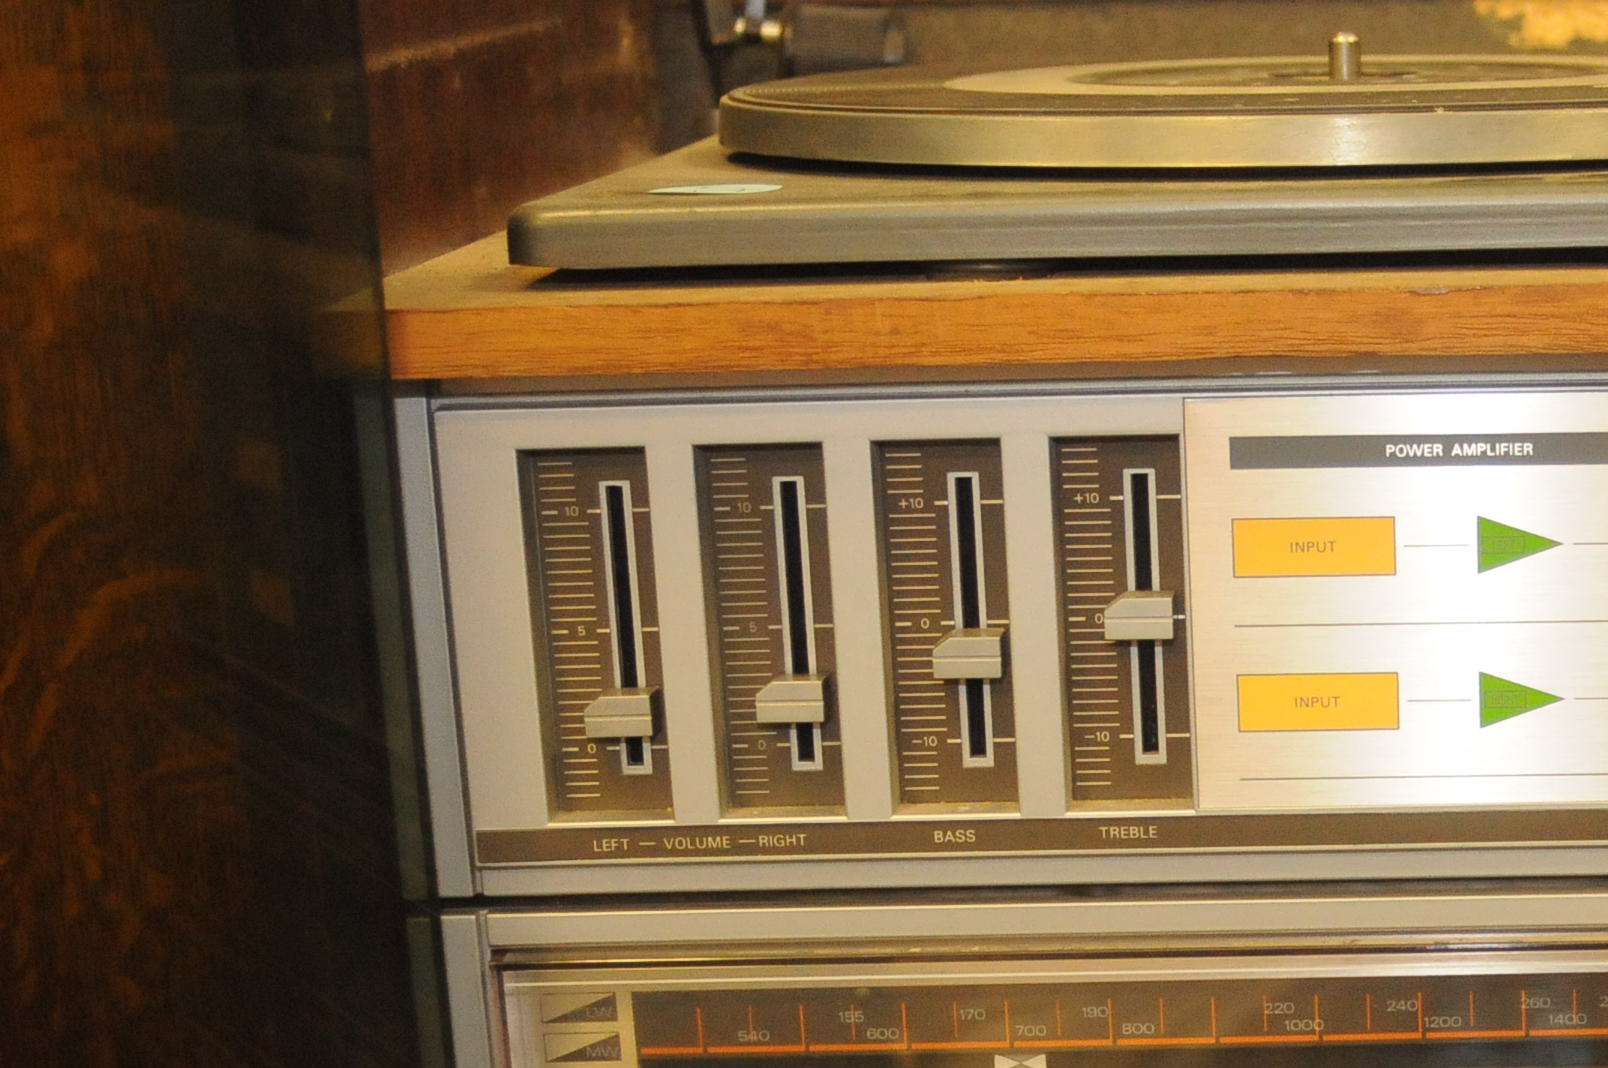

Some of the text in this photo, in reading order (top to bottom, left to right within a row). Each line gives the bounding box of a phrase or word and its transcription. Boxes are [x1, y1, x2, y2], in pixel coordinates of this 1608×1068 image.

[1385, 442, 1533, 458] POWER AMPLIFIER
[1074, 492, 1099, 503] +10
[737, 502, 752, 513] 10
[899, 498, 924, 509] +10
[564, 506, 579, 517] 10
[1289, 540, 1336, 554] INPUT
[920, 618, 930, 629] 0
[1095, 613, 1103, 624] 0
[577, 625, 587, 636] 5
[748, 622, 758, 633] 5
[1294, 695, 1340, 709] INPUT
[586, 743, 596, 754] 0
[757, 739, 767, 750] 0
[934, 829, 976, 843] BASS
[1099, 825, 1158, 840] TREBLE
[593, 832, 807, 853] LEFT VOLUME RIGHT
[960, 1008, 986, 1021] 170
[1082, 1006, 1108, 1018] 190
[1264, 1002, 1295, 1014] 220
[1386, 1000, 1418, 1012] 240
[737, 1030, 770, 1042] 540
[866, 1027, 899, 1040] 600
[1015, 1024, 1047, 1037] 700
[1122, 1022, 1155, 1035] 800
[1285, 1019, 1325, 1031] 1000
[1423, 1016, 1462, 1028] 1200
[1548, 1013, 1587, 1025] 1400
[586, 1046, 620, 1058] MW
